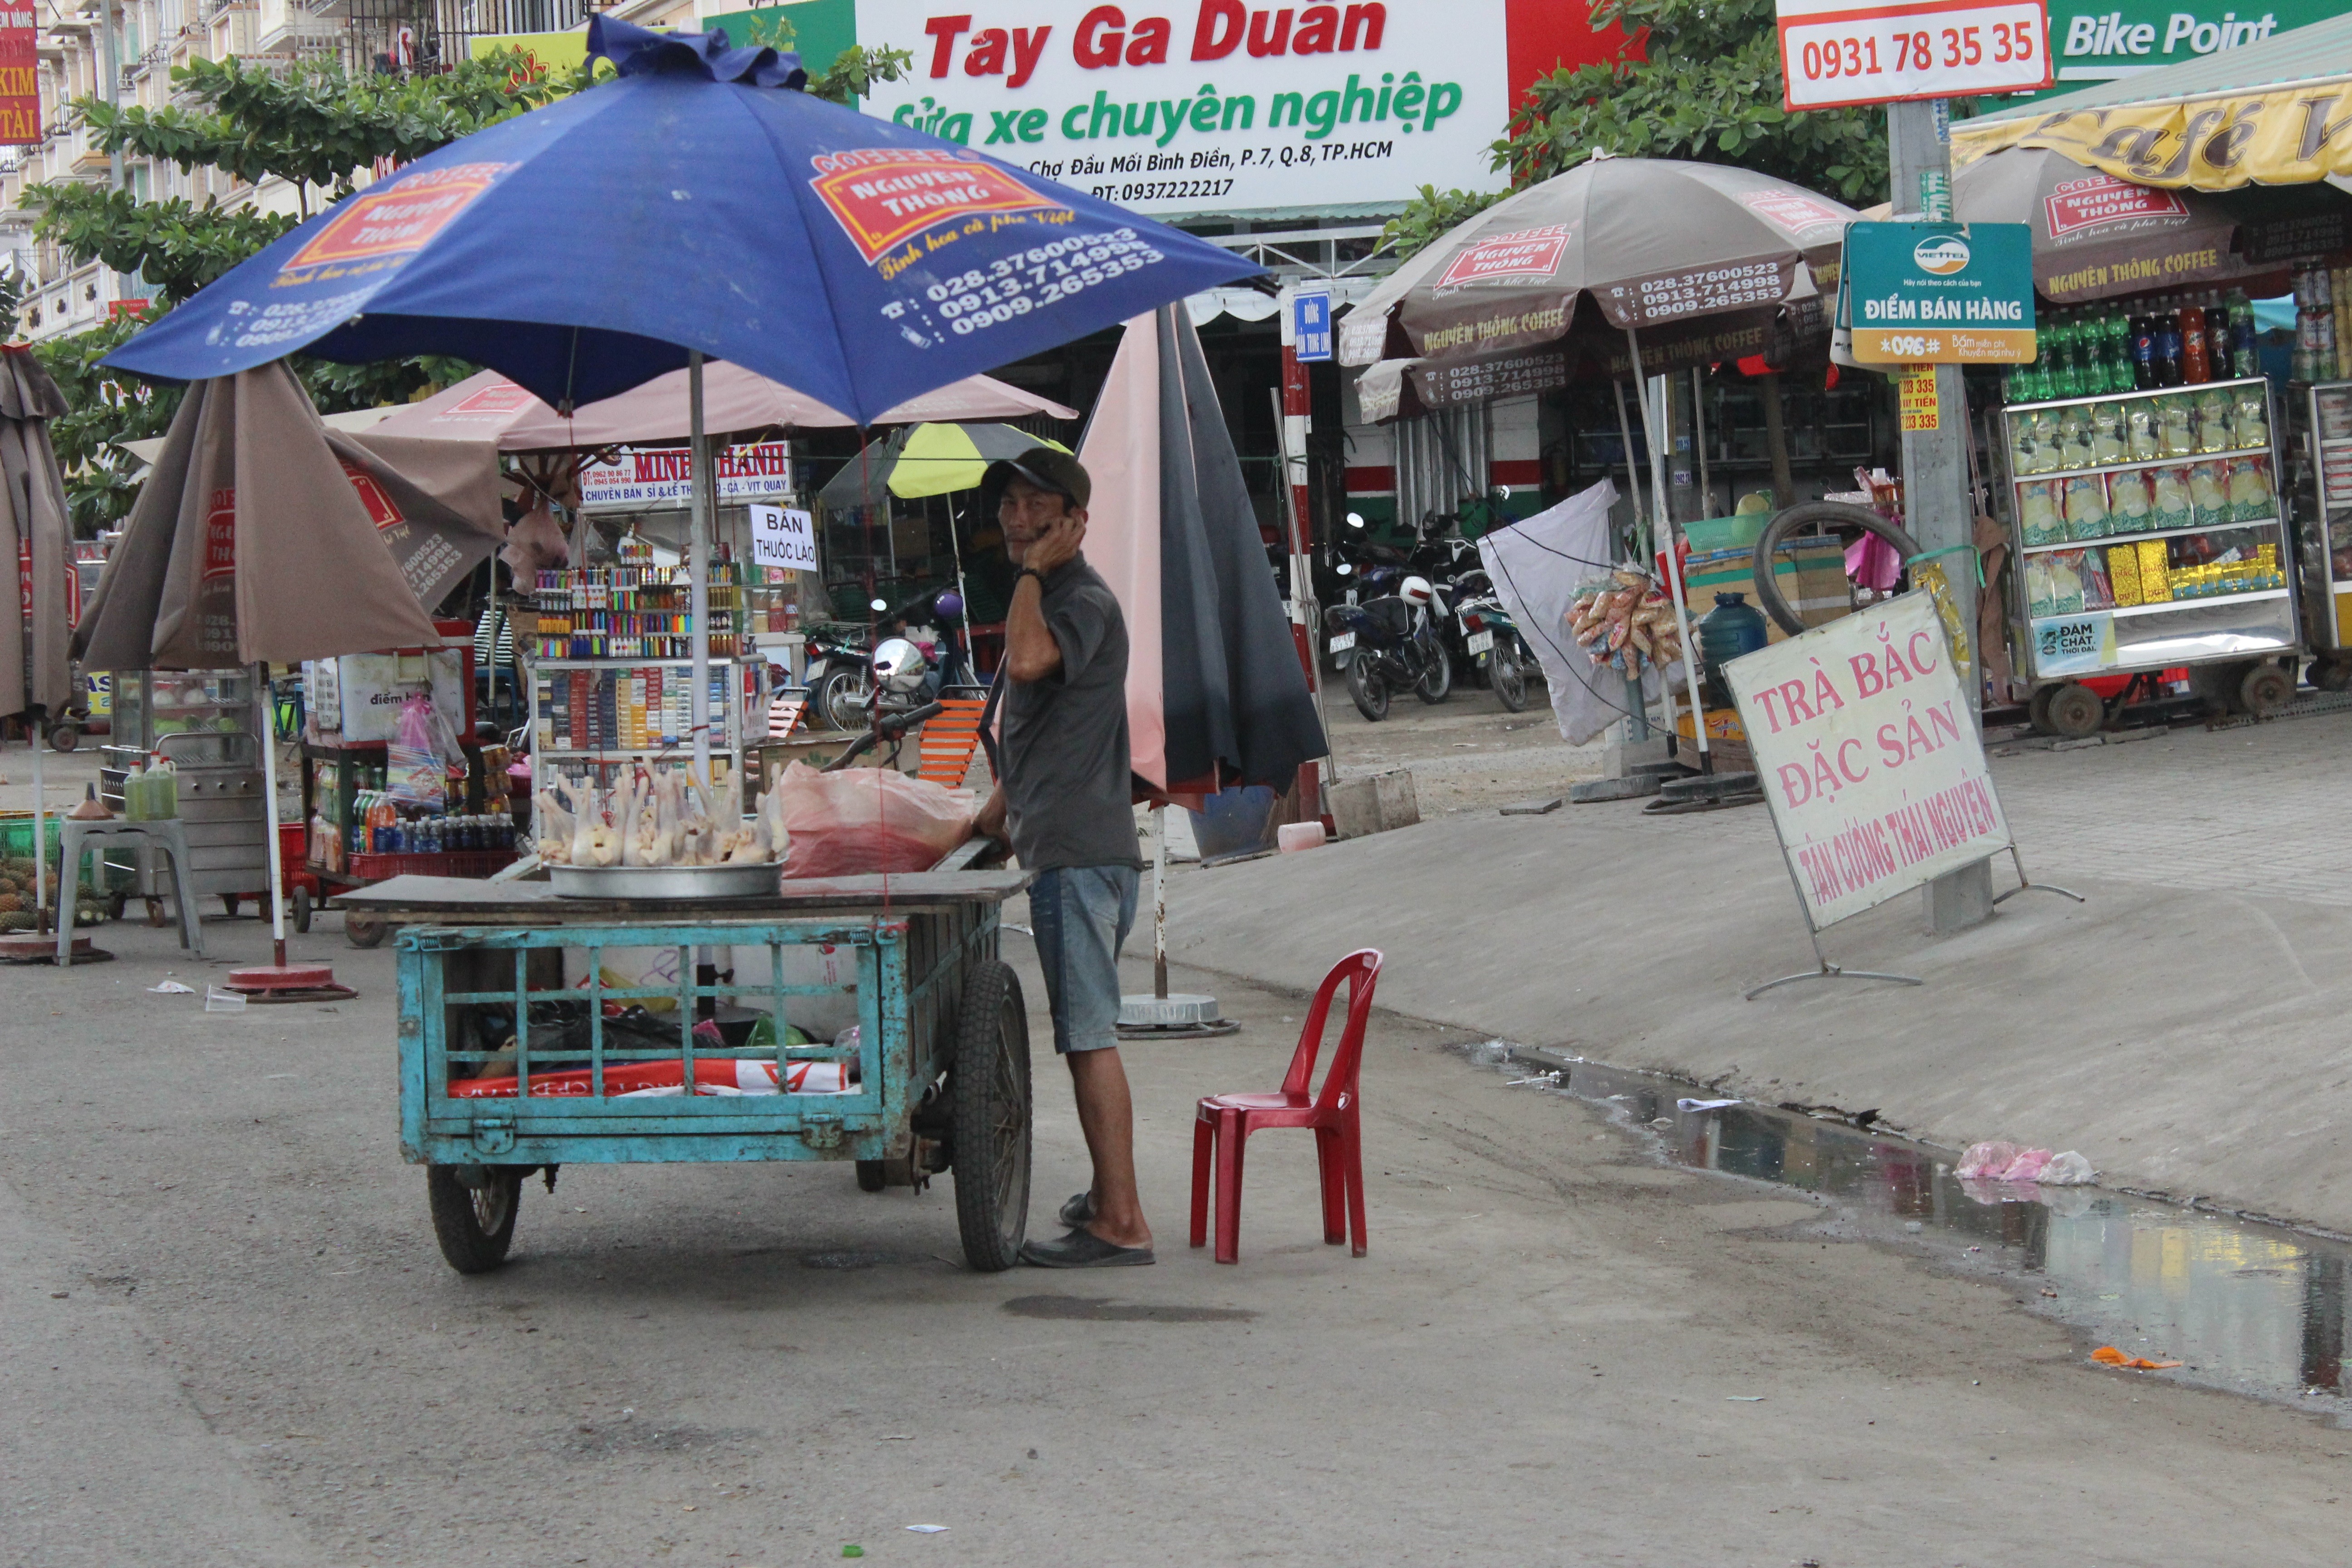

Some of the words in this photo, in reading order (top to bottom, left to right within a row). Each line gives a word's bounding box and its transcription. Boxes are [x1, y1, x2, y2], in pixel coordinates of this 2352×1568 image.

[11, 8, 33, 28] VÀNG
[2063, 12, 2155, 56] Bike
[2162, 13, 2278, 54] Point
[925, 14, 1052, 88] Tay
[1073, 5, 1171, 69] Ga
[1803, 36, 1882, 80] 0931
[1892, 32, 1932, 72] 78
[1942, 26, 1981, 68] 35
[1993, 21, 2033, 63] 35
[0, 101, 35, 138] TÀI
[985, 108, 1048, 144] xe
[1061, 83, 1256, 148] chuyên
[1269, 71, 1462, 140] nghiệp
[1030, 160, 1063, 181] Chợ
[1071, 156, 1104, 174] Đầu
[1110, 152, 1141, 172] Mối
[1147, 148, 1184, 171] Bình
[1191, 146, 1235, 171] Điền,
[1241, 147, 1274, 168] P.7,
[1280, 145, 1315, 167] Q.8,
[1322, 141, 1392, 162] TP.HCM
[881, 185, 992, 217] THÔNG
[1091, 185, 1119, 202] ĐT:
[1122, 180, 1234, 201] 0937.222217
[2066, 187, 2150, 208] NGUYÊN
[2078, 199, 2148, 218] THÔNG
[877, 242, 923, 280] Tinh
[926, 229, 959, 258] hoa
[963, 219, 985, 238] cà
[926, 226, 1138, 303] 028.37600523
[1473, 255, 1536, 272] THÔNG
[1641, 262, 1778, 294] 028.37600523
[2048, 265, 2108, 295] NGUYÊN
[2111, 258, 2160, 282] THÔNG
[2164, 249, 2217, 273] COFFEE
[951, 250, 1166, 335] 0909.265353
[1643, 275, 1780, 305] 0913.714998
[1645, 287, 1783, 318] 0909.265353
[1865, 293, 1916, 320] ĐIỂM
[1921, 296, 1961, 320] BÁN
[1966, 297, 2022, 320] HÀNG
[1424, 322, 1473, 352] NGUYÊN
[1477, 315, 1518, 339] THÔNG
[1521, 308, 1565, 332] COFFEE
[1952, 334, 1974, 348] Bấm
[1916, 379, 1934, 393] 335
[1920, 414, 1937, 428] 335
[585, 488, 621, 501] CHUYÊN
[623, 485, 642, 499] BÁN
[746, 480, 760, 494] VỊT
[763, 479, 787, 492] QUAY
[766, 511, 803, 534] BÁN
[756, 537, 793, 560] THUỐC
[794, 542, 815, 563] LÀO
[1753, 656, 1845, 734] TRÀ
[1848, 621, 1937, 700] BẮC
[370, 692, 402, 705] điểm
[1776, 738, 1870, 809] ĐẶC
[1877, 699, 1961, 769] SẢN
[1798, 832, 1843, 906] TÂN
[1886, 789, 1936, 867] THÁI
[1924, 768, 1998, 852] NGUYÊN
